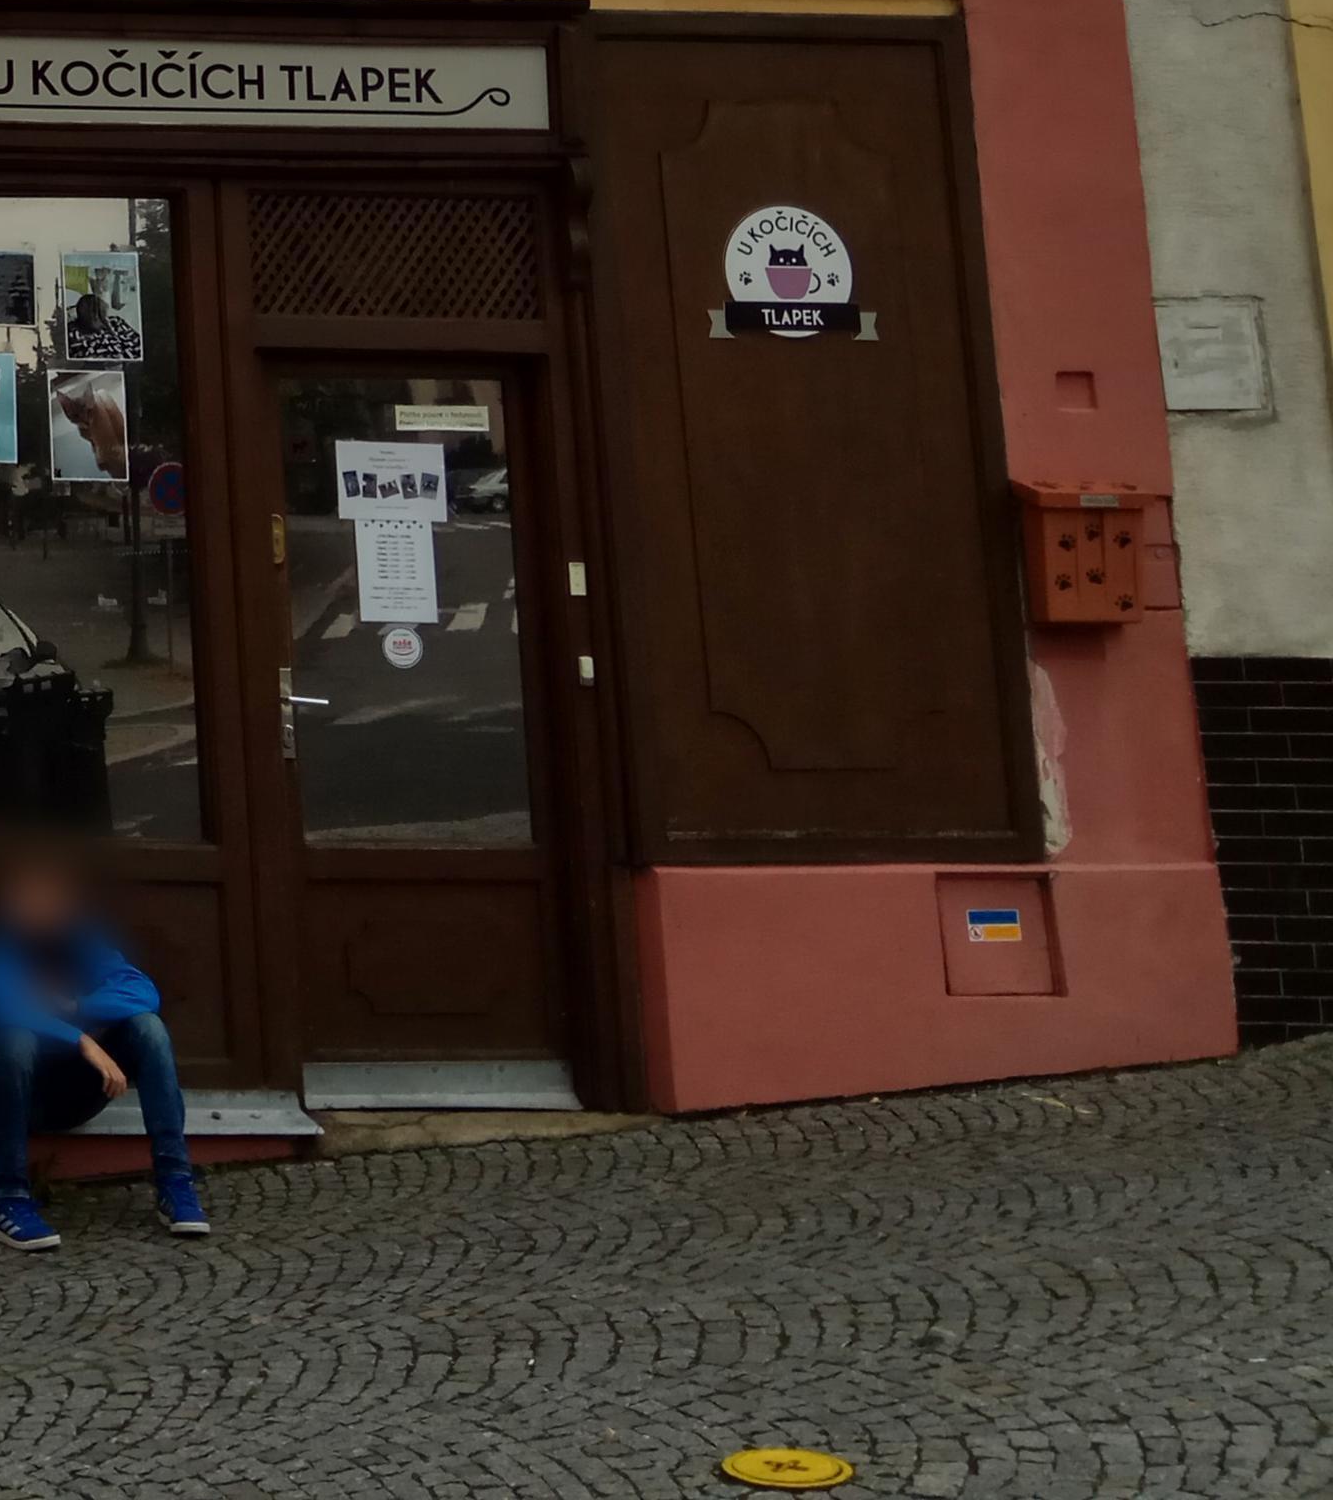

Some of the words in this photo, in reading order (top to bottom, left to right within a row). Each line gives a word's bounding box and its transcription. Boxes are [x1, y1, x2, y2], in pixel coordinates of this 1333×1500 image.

[32, 49, 264, 100] KOČIČÍCH
[280, 65, 443, 104] TLAPEK
[737, 241, 753, 256] U
[747, 211, 836, 257] KOČIČÍCH
[761, 308, 824, 325] TLAPEK
